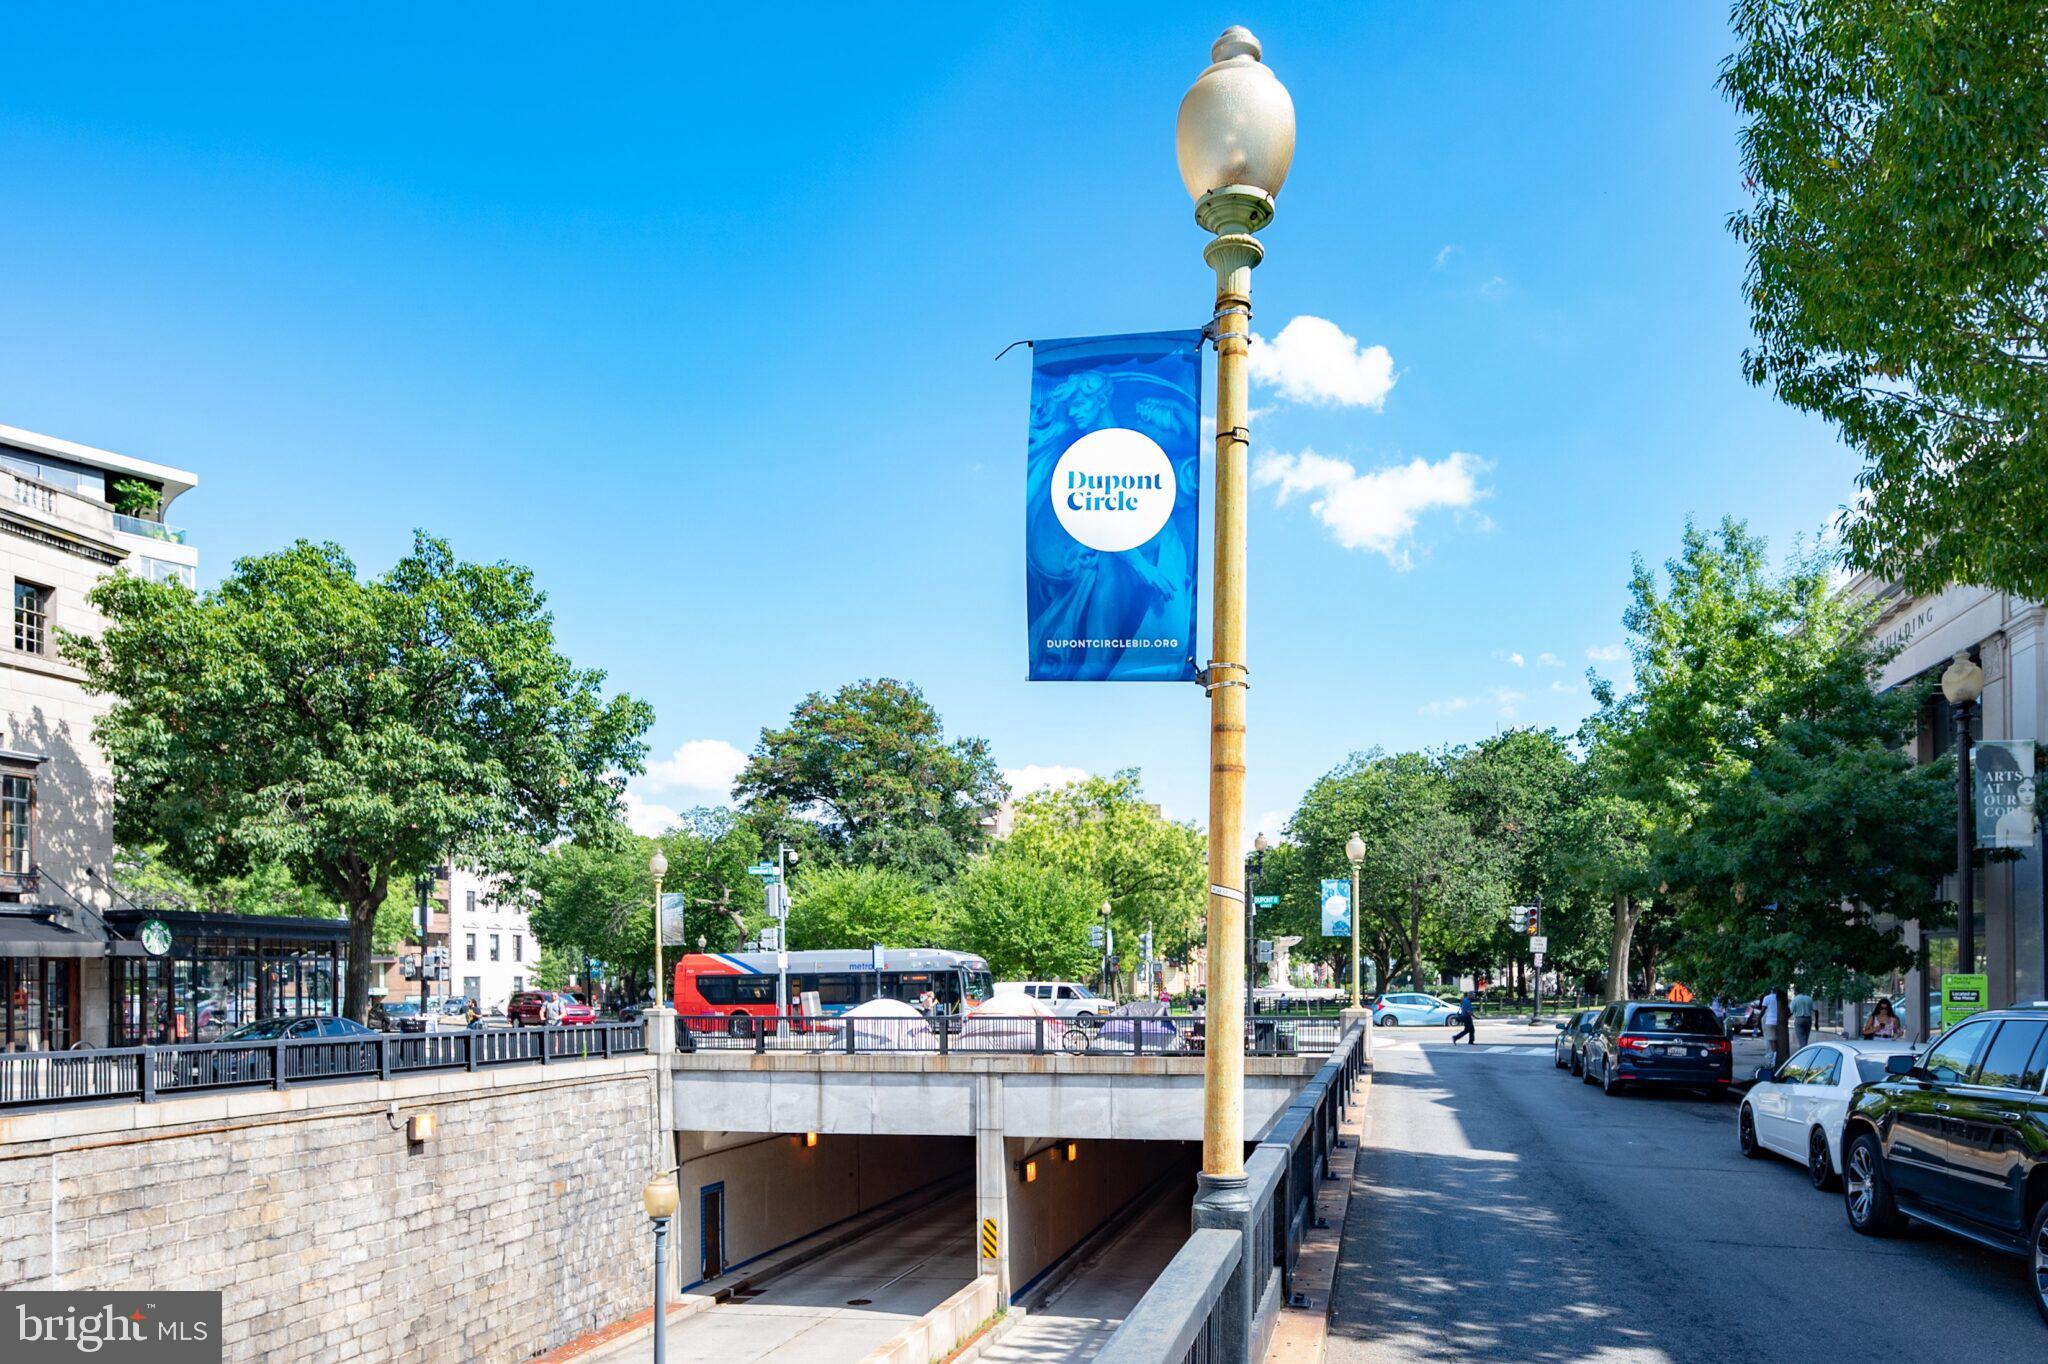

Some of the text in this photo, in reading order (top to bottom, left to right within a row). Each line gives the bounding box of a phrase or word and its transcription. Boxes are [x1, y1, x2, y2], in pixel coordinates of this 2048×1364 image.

[1067, 471, 1162, 494] Dupont
[1067, 491, 1138, 511] Circle
[1046, 639, 1178, 648] DUPONTCIRCLEBID.ORG
[1984, 771, 2023, 782] ARTS
[1984, 783, 2004, 794] AT
[1984, 795, 2017, 806] OUR
[1984, 806, 2022, 818] COR
[849, 963, 889, 971] metros
